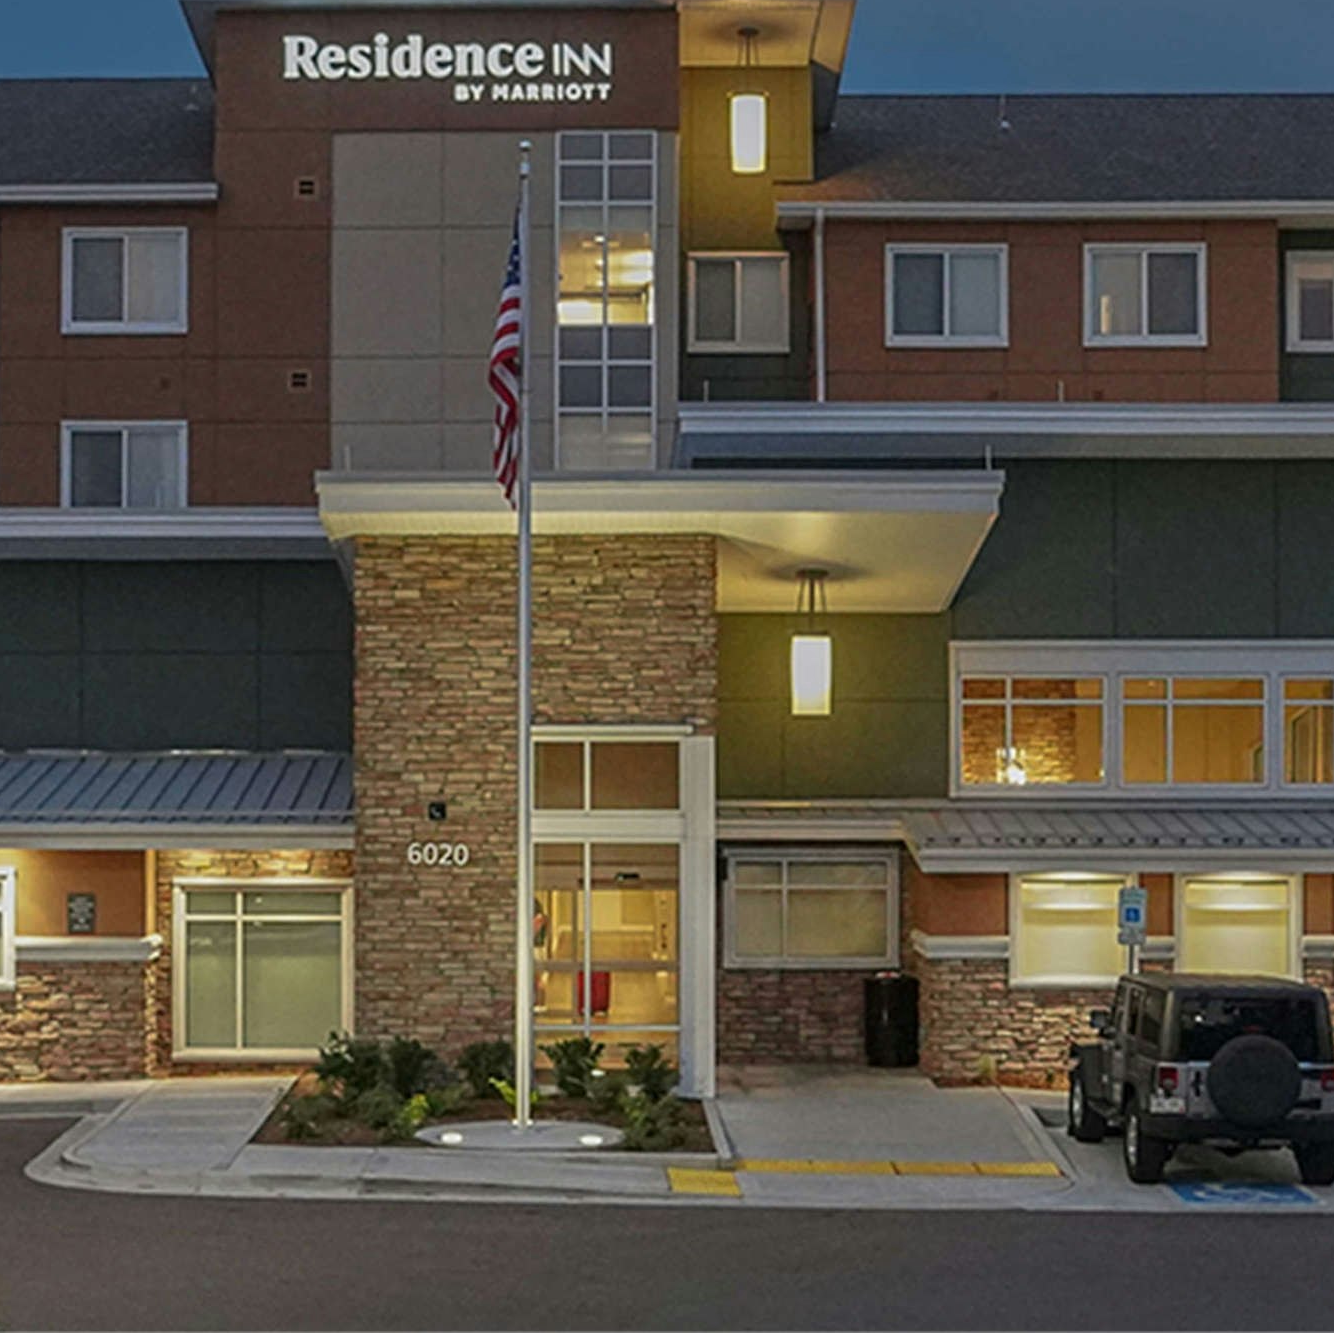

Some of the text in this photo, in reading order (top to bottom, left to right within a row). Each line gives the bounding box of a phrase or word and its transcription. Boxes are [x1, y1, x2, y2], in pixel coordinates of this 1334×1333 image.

[282, 33, 612, 79] Residence INN
[454, 83, 612, 101] BY MARRIOTT
[407, 842, 470, 866] 6020
